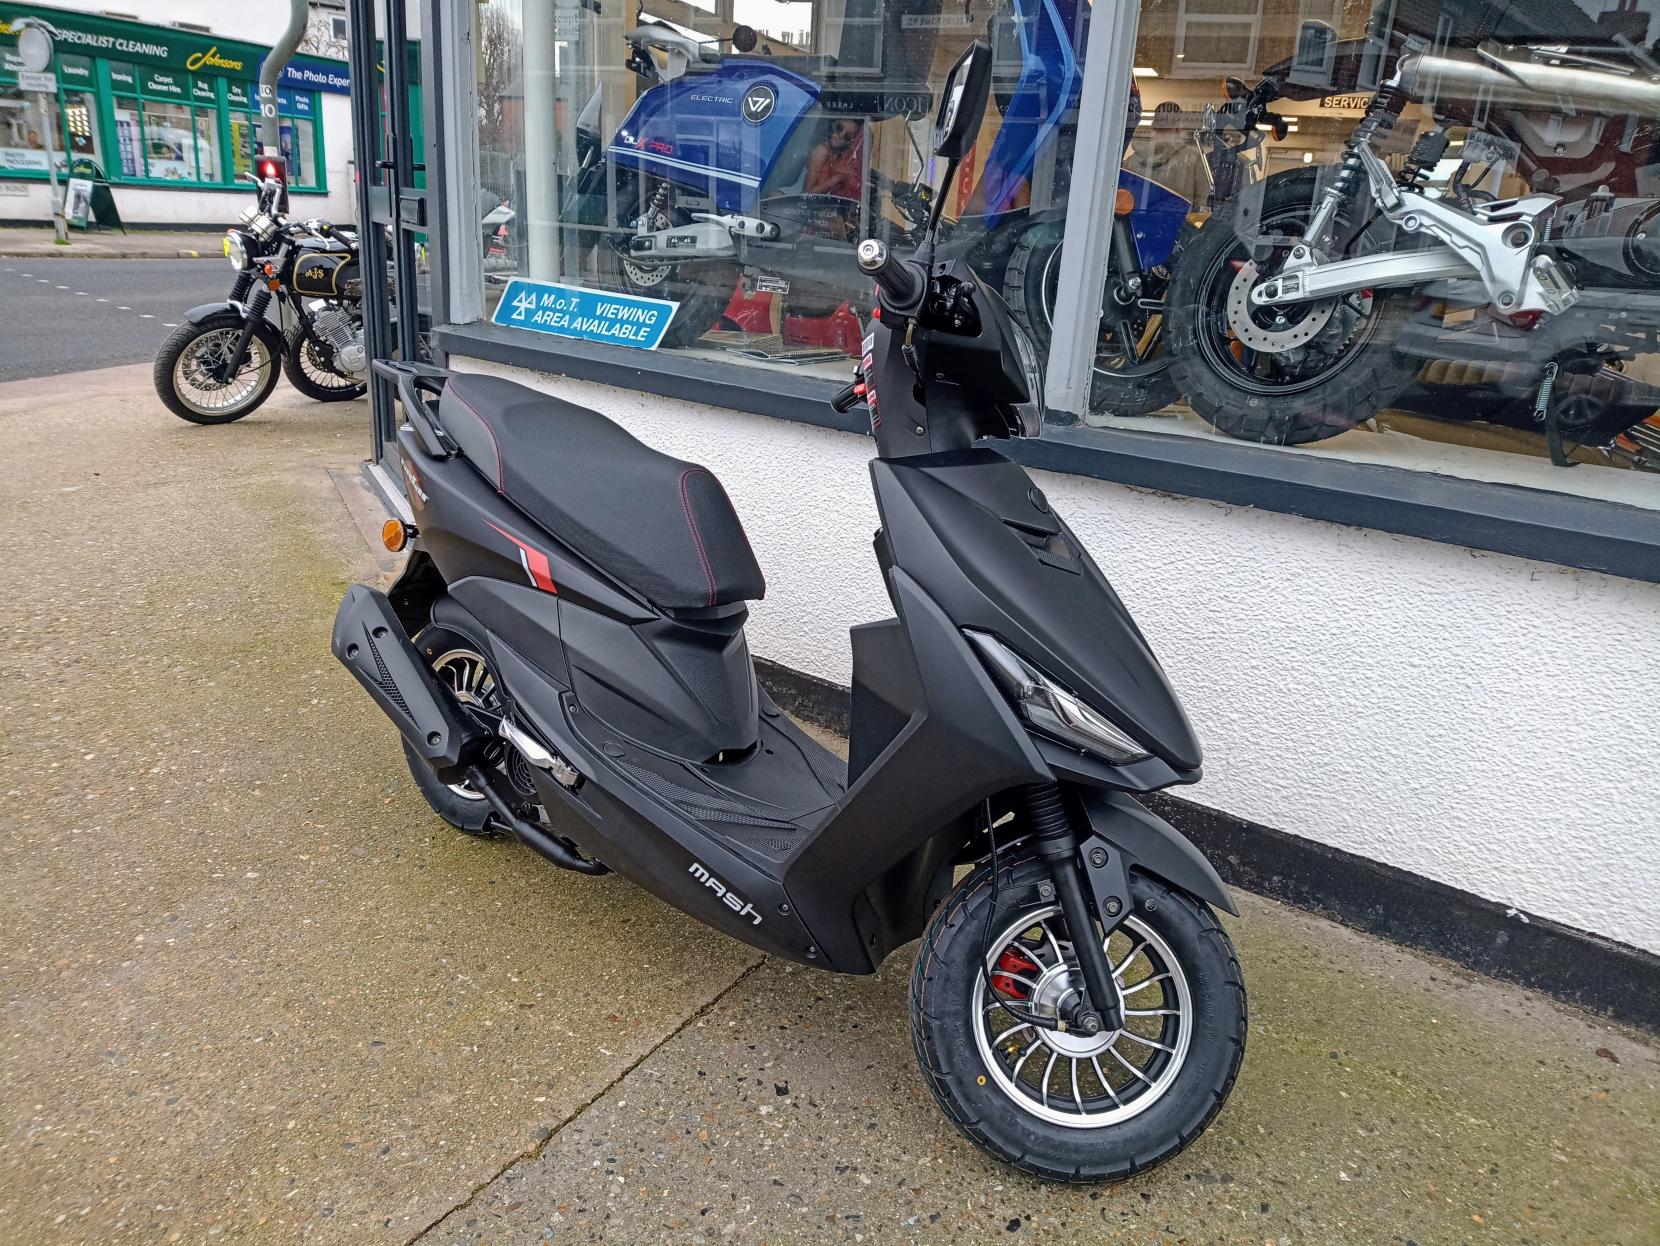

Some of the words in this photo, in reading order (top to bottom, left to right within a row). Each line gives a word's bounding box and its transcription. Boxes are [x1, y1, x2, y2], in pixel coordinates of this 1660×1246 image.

[55, 28, 116, 48] SPECIALIST
[115, 38, 169, 57] CLEANING
[186, 46, 244, 70] Johnsons
[154, 74, 174, 84] Carpet
[287, 67, 302, 80] The
[303, 70, 327, 83] Photo
[197, 80, 209, 90] Rug
[231, 85, 242, 94] Dry
[192, 88, 216, 99] Cleaning
[227, 93, 248, 104] Cleaning
[295, 95, 310, 103] Photo
[690, 94, 734, 104] ELECTRIC
[260, 103, 276, 118] 10
[650, 141, 673, 155] PRO
[540, 293, 580, 312] M.o.T.
[596, 302, 658, 325] VIEWING
[531, 310, 569, 328] AREA
[570, 316, 651, 341] AVAILABLE
